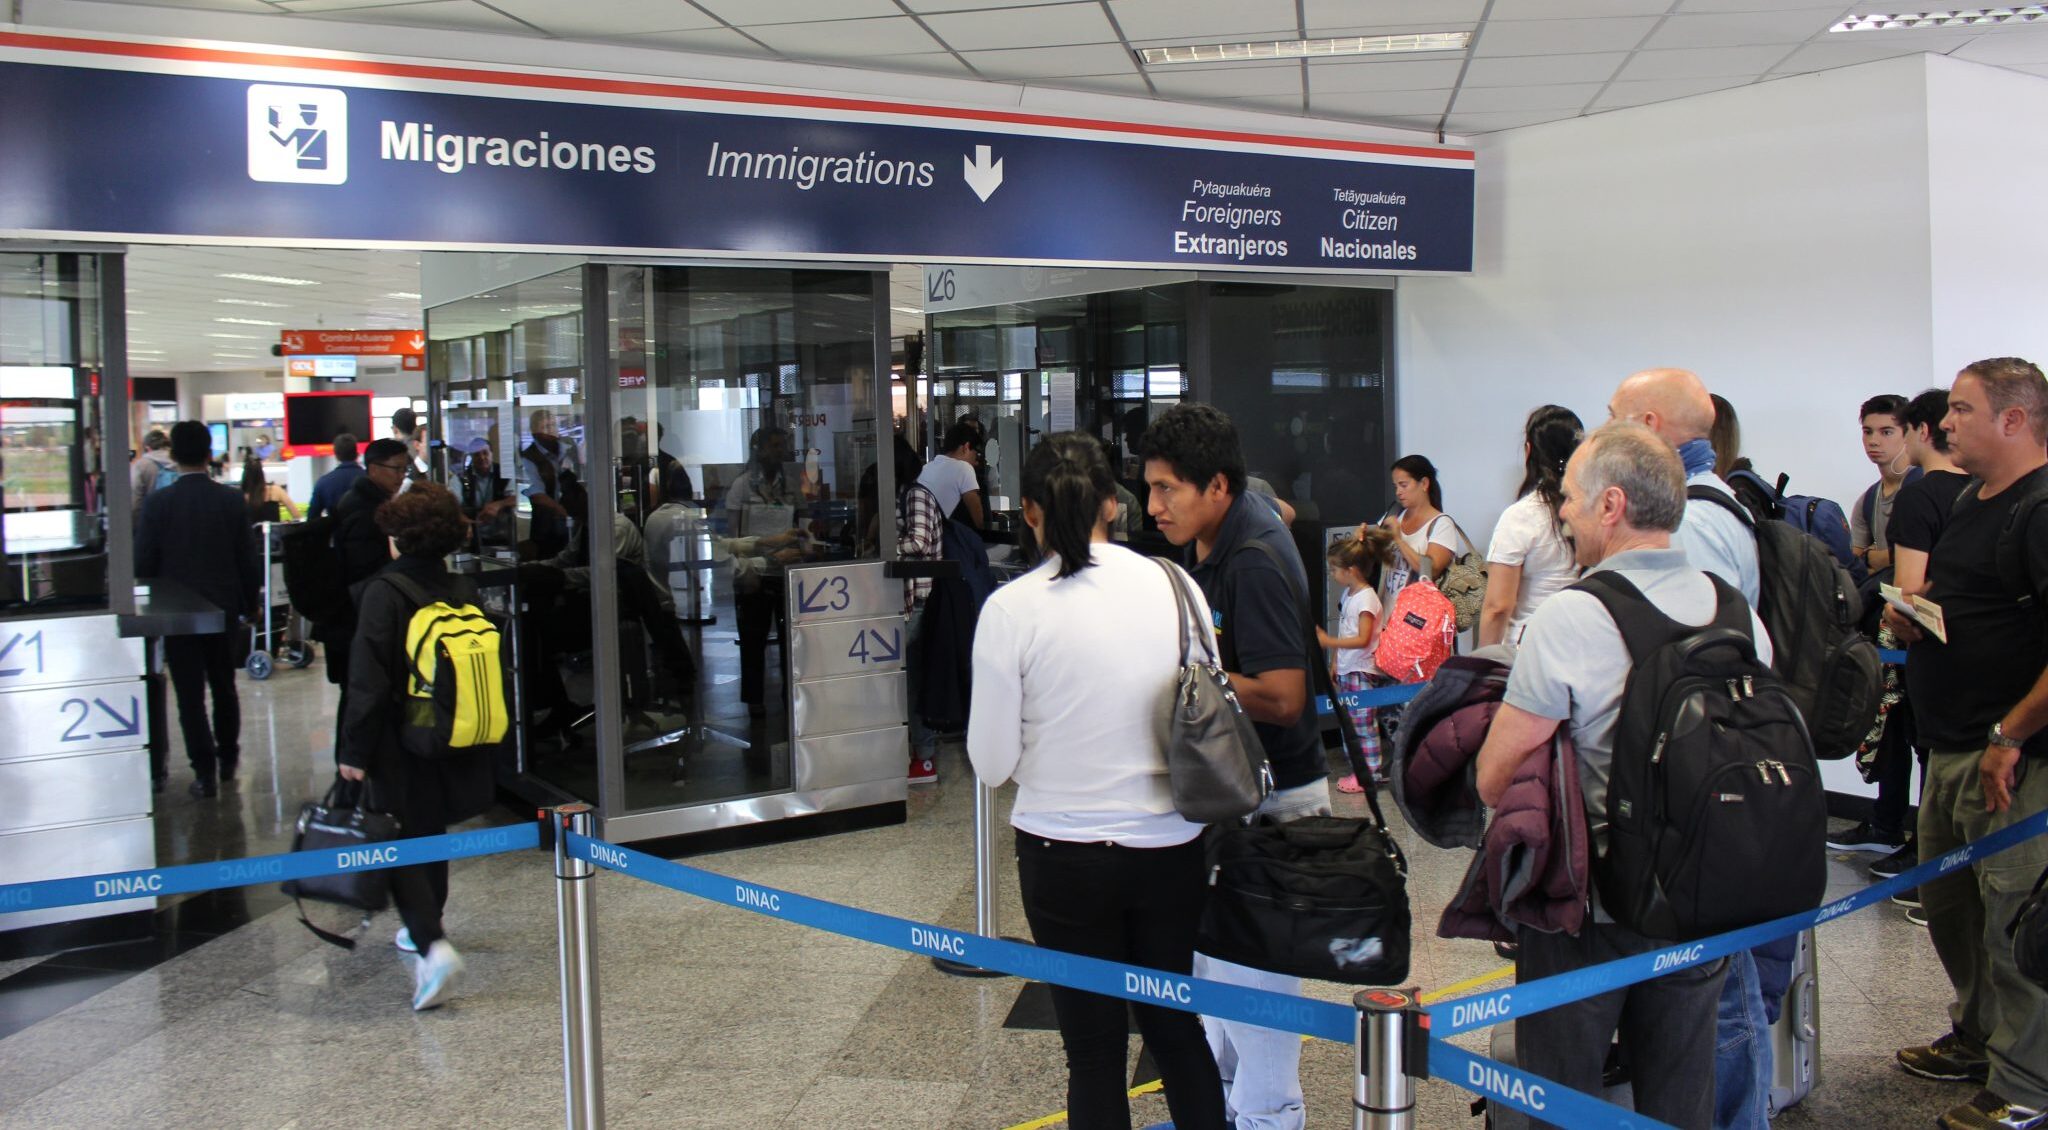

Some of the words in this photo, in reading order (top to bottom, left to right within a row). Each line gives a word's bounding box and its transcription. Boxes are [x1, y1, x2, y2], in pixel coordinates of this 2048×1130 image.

[380, 120, 656, 174] Migraciones
[706, 142, 935, 190] Immigrations
[1193, 179, 1271, 198] Pytaguakuéra
[1182, 200, 1282, 230] Foreigners
[1342, 208, 1398, 231] Citizen
[1174, 231, 1288, 260] Extranjeros
[1321, 237, 1417, 260] Nacionales
[944, 269, 956, 301] 6
[830, 575, 850, 611] 3
[24, 630, 44, 673] 1
[848, 629, 869, 664] 4
[60, 698, 92, 742] 2
[337, 846, 398, 869] DINAC
[589, 842, 628, 869] DINAC
[1940, 846, 1974, 872] DINAC
[94, 874, 163, 898] DINAC
[736, 885, 781, 912] DINAC
[1814, 896, 1858, 924] DINAC
[910, 926, 966, 957] DINAC
[1653, 944, 1705, 974] DINAC
[1124, 971, 1193, 1005] DINAC
[1451, 993, 1513, 1029] DINAC
[1467, 1060, 1546, 1112] DINAC
